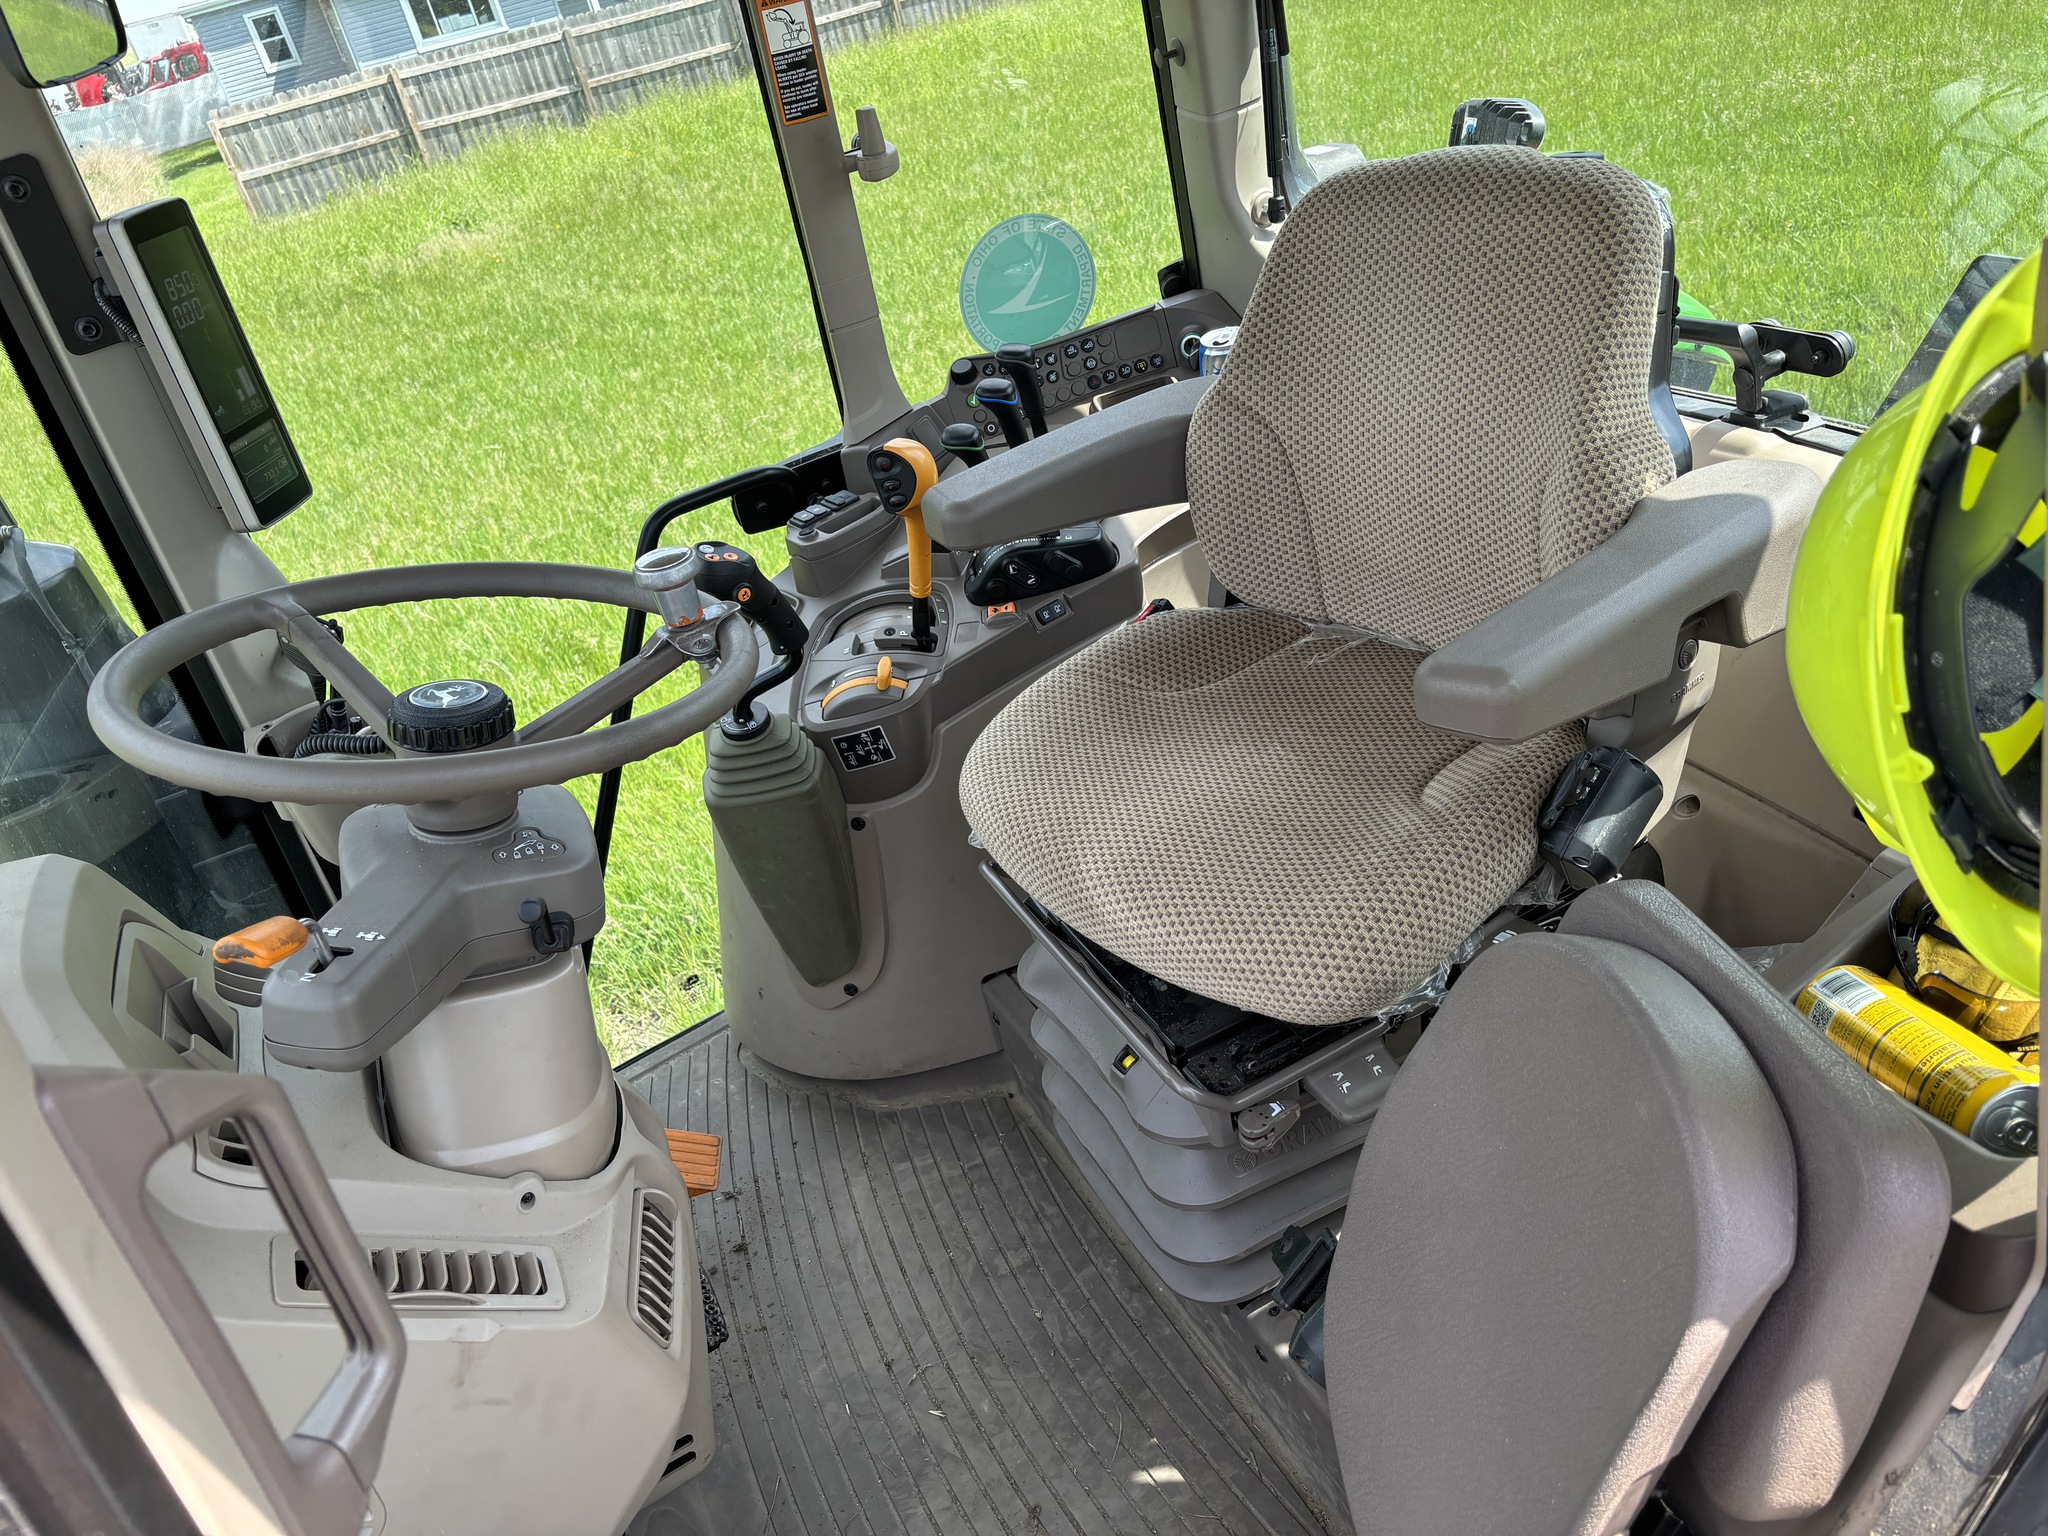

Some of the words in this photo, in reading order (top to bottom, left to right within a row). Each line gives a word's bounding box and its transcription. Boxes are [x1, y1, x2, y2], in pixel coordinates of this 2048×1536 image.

[299, 972, 318, 983] N
[1915, 1041, 1958, 1074] Calories
[1932, 1055, 1978, 1090] Nutrition
